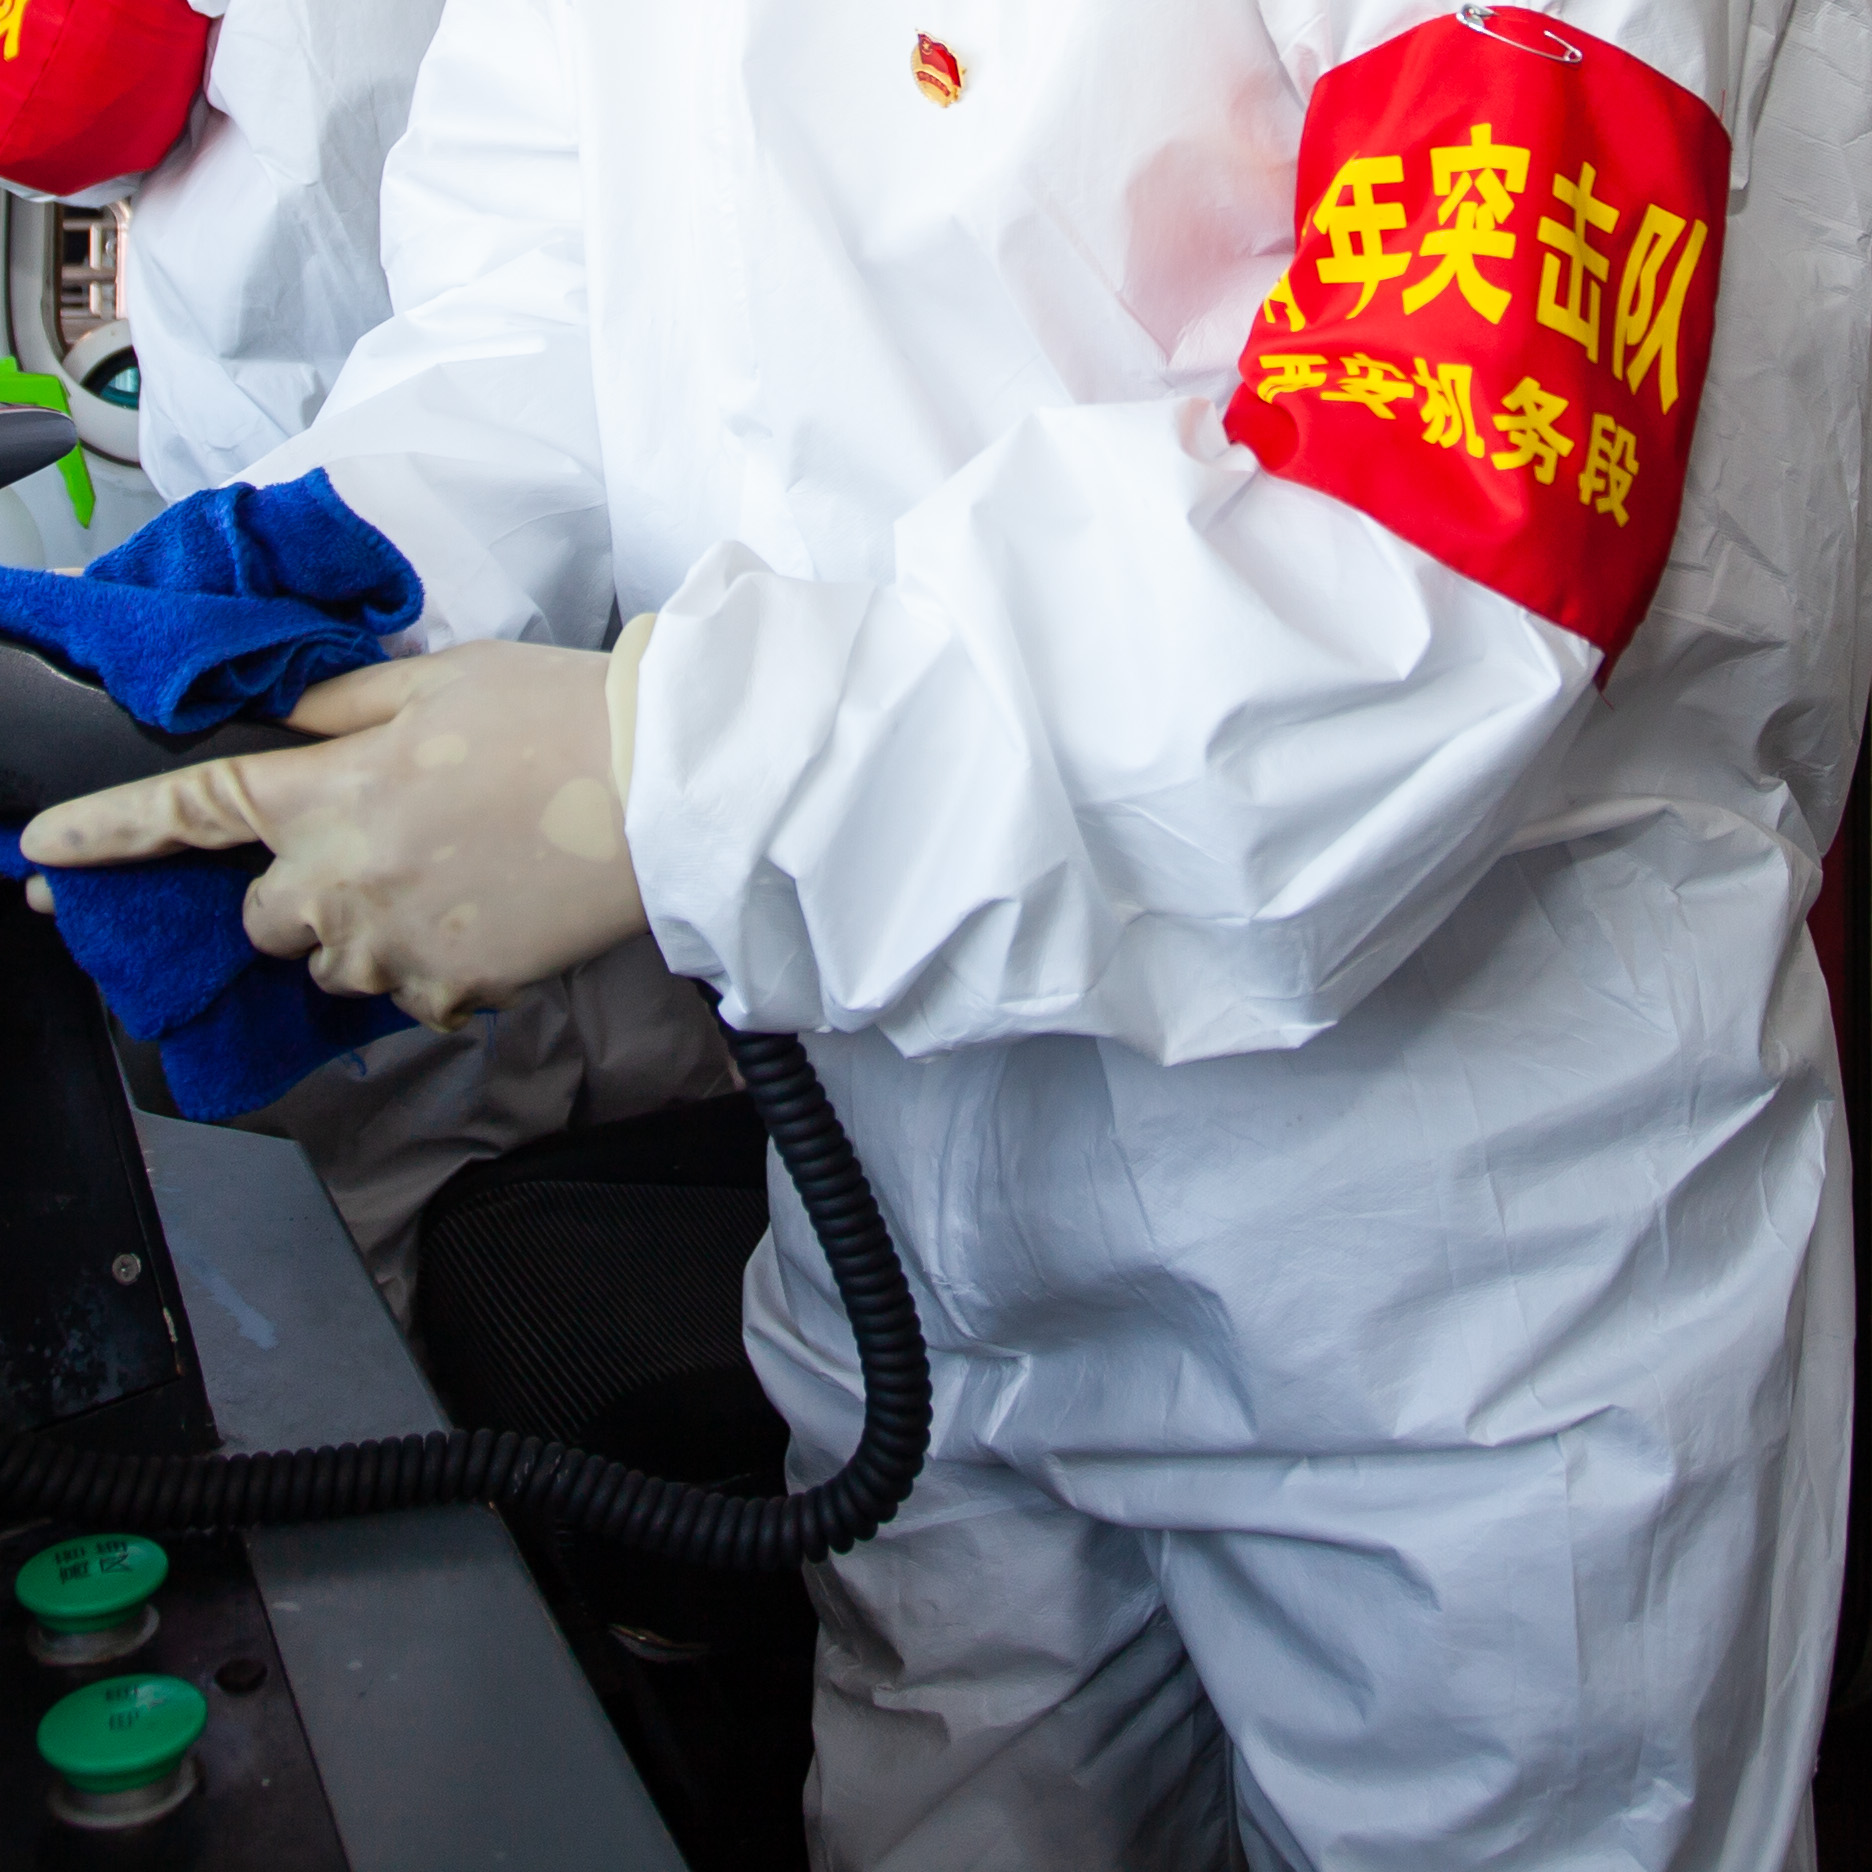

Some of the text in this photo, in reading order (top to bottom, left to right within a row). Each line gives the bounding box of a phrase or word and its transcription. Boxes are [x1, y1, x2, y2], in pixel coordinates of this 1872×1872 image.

[1261, 122, 1710, 416] 年突击队
[1256, 352, 1641, 528] 西安机务段
